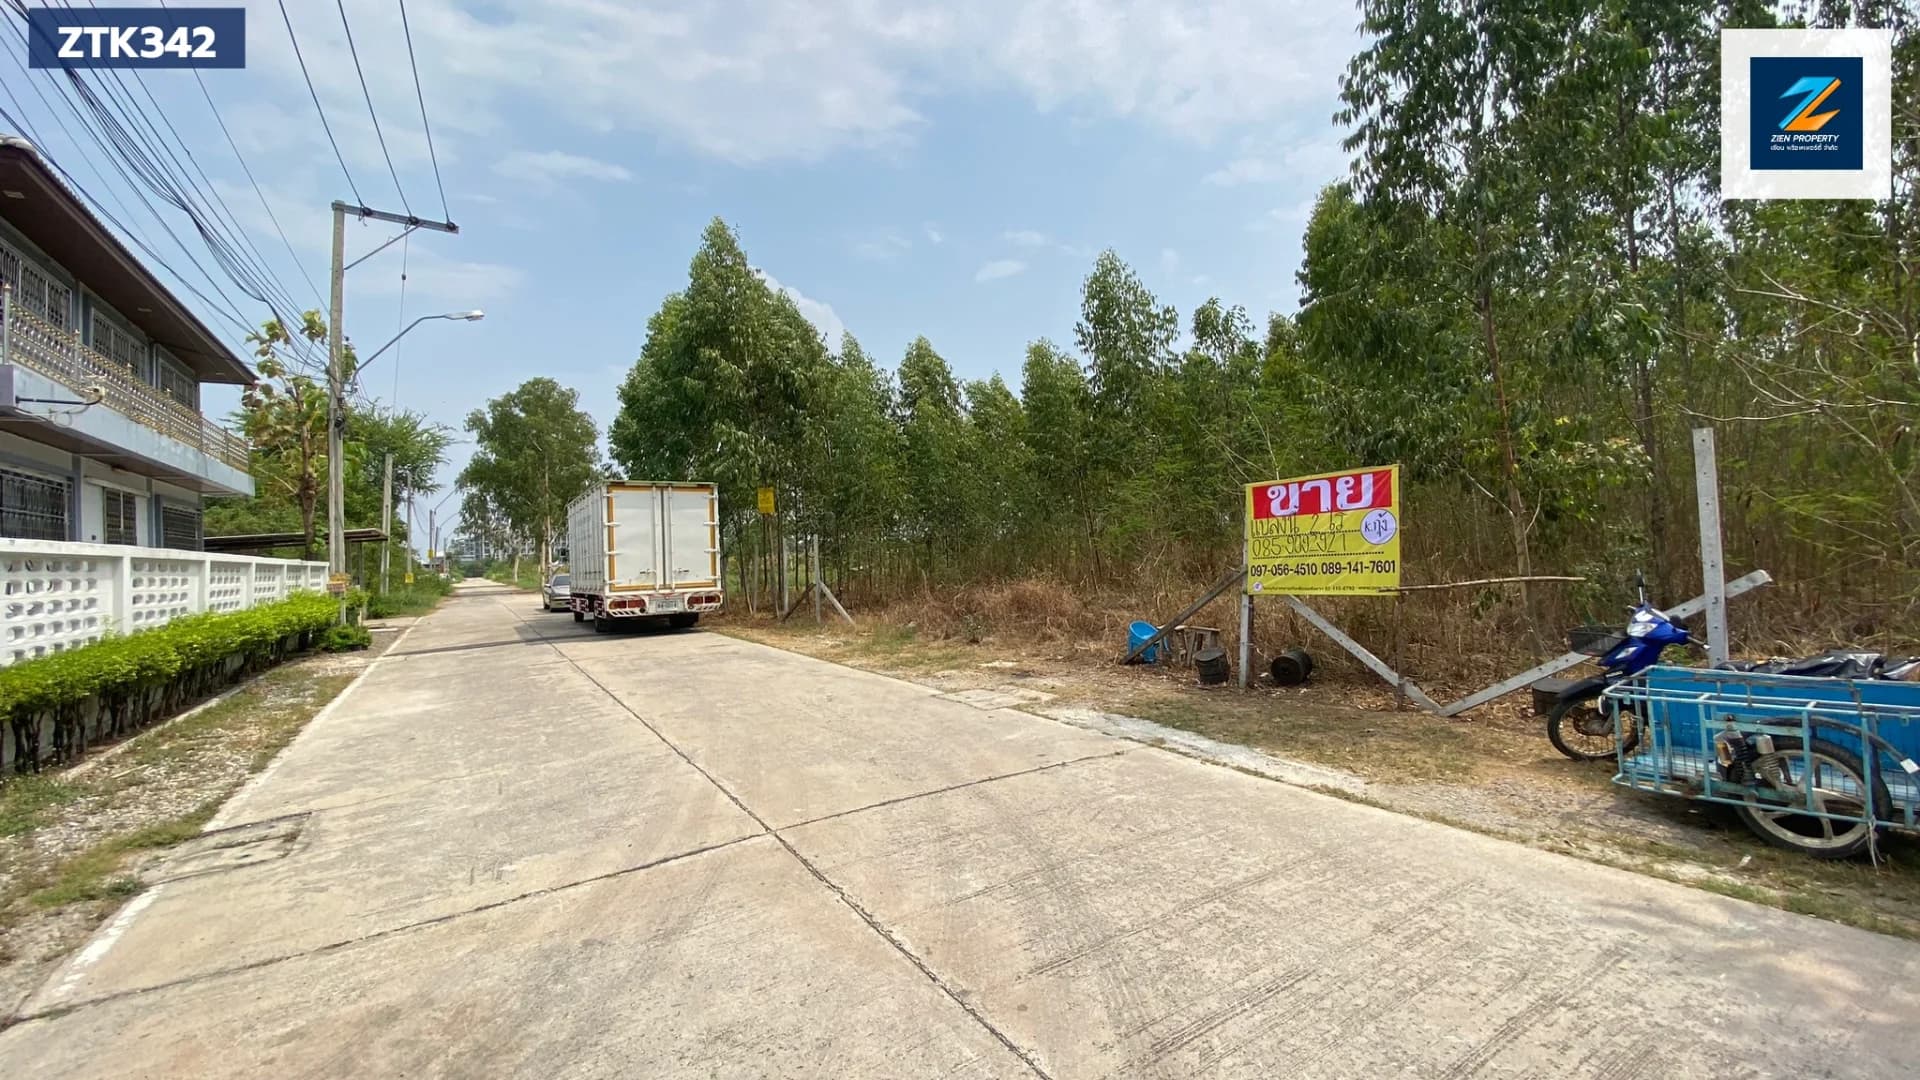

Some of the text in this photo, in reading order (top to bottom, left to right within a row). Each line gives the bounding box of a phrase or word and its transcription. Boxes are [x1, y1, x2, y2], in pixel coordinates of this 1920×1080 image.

[1267, 473, 1374, 517] ขาย
[1250, 560, 1396, 577] 097-056-4510 089-141-7601
